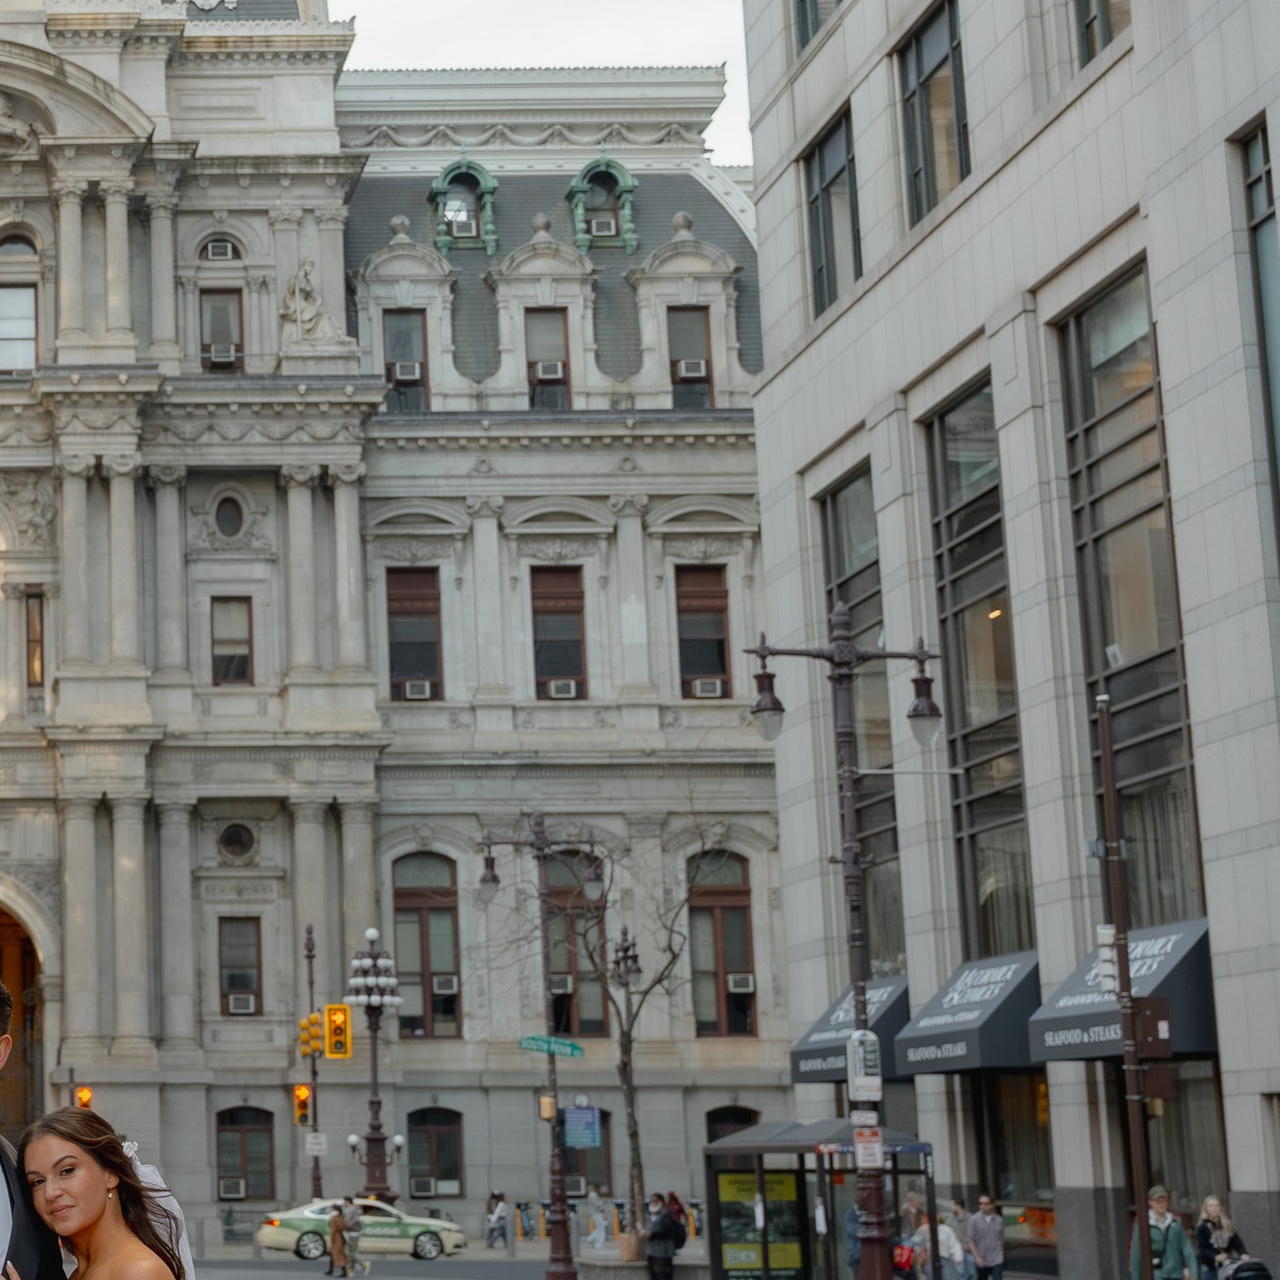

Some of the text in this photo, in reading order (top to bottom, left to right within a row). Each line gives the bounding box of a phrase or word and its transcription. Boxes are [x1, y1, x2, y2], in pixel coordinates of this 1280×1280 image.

[1044, 1023, 1122, 1047] SEAFOOD & STEAKS
[521, 1039, 548, 1051] SOUTH
[549, 1042, 572, 1055] PENN
[907, 1045, 937, 1062] SEAFOOD
